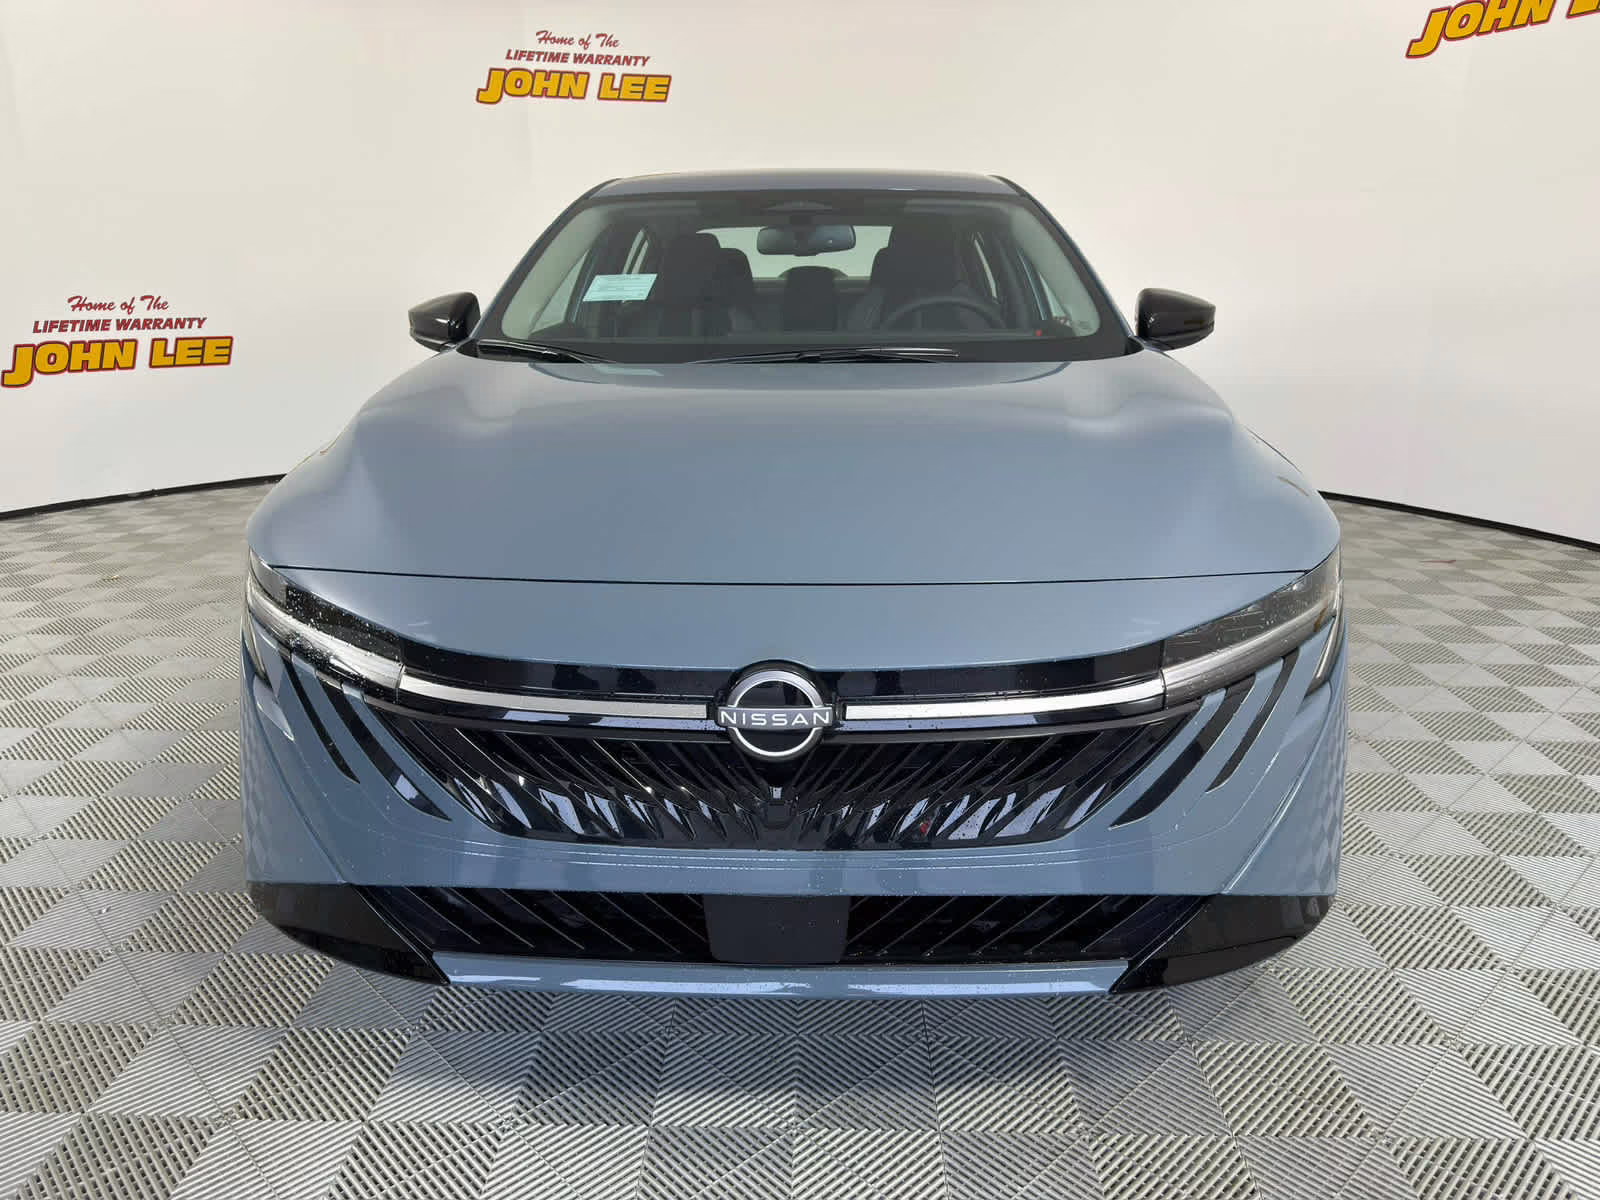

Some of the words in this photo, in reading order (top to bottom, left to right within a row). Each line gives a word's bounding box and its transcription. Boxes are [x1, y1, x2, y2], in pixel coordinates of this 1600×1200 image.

[1405, 0, 1557, 58] JOHN
[536, 30, 574, 46] Home
[578, 34, 591, 50] of
[595, 33, 620, 48] The
[506, 49, 570, 64] LIFETIME
[573, 52, 651, 67] WARRANTY
[476, 67, 590, 105] JOHN
[597, 73, 672, 103] LEE
[67, 295, 115, 312] Home
[120, 297, 135, 315] of
[140, 295, 169, 311] The
[33, 318, 112, 334] LIFETIME
[116, 317, 207, 331] WARRANTY
[1, 338, 138, 388] JOHN
[149, 336, 233, 368] LEE
[720, 710, 830, 726] NISSAN
